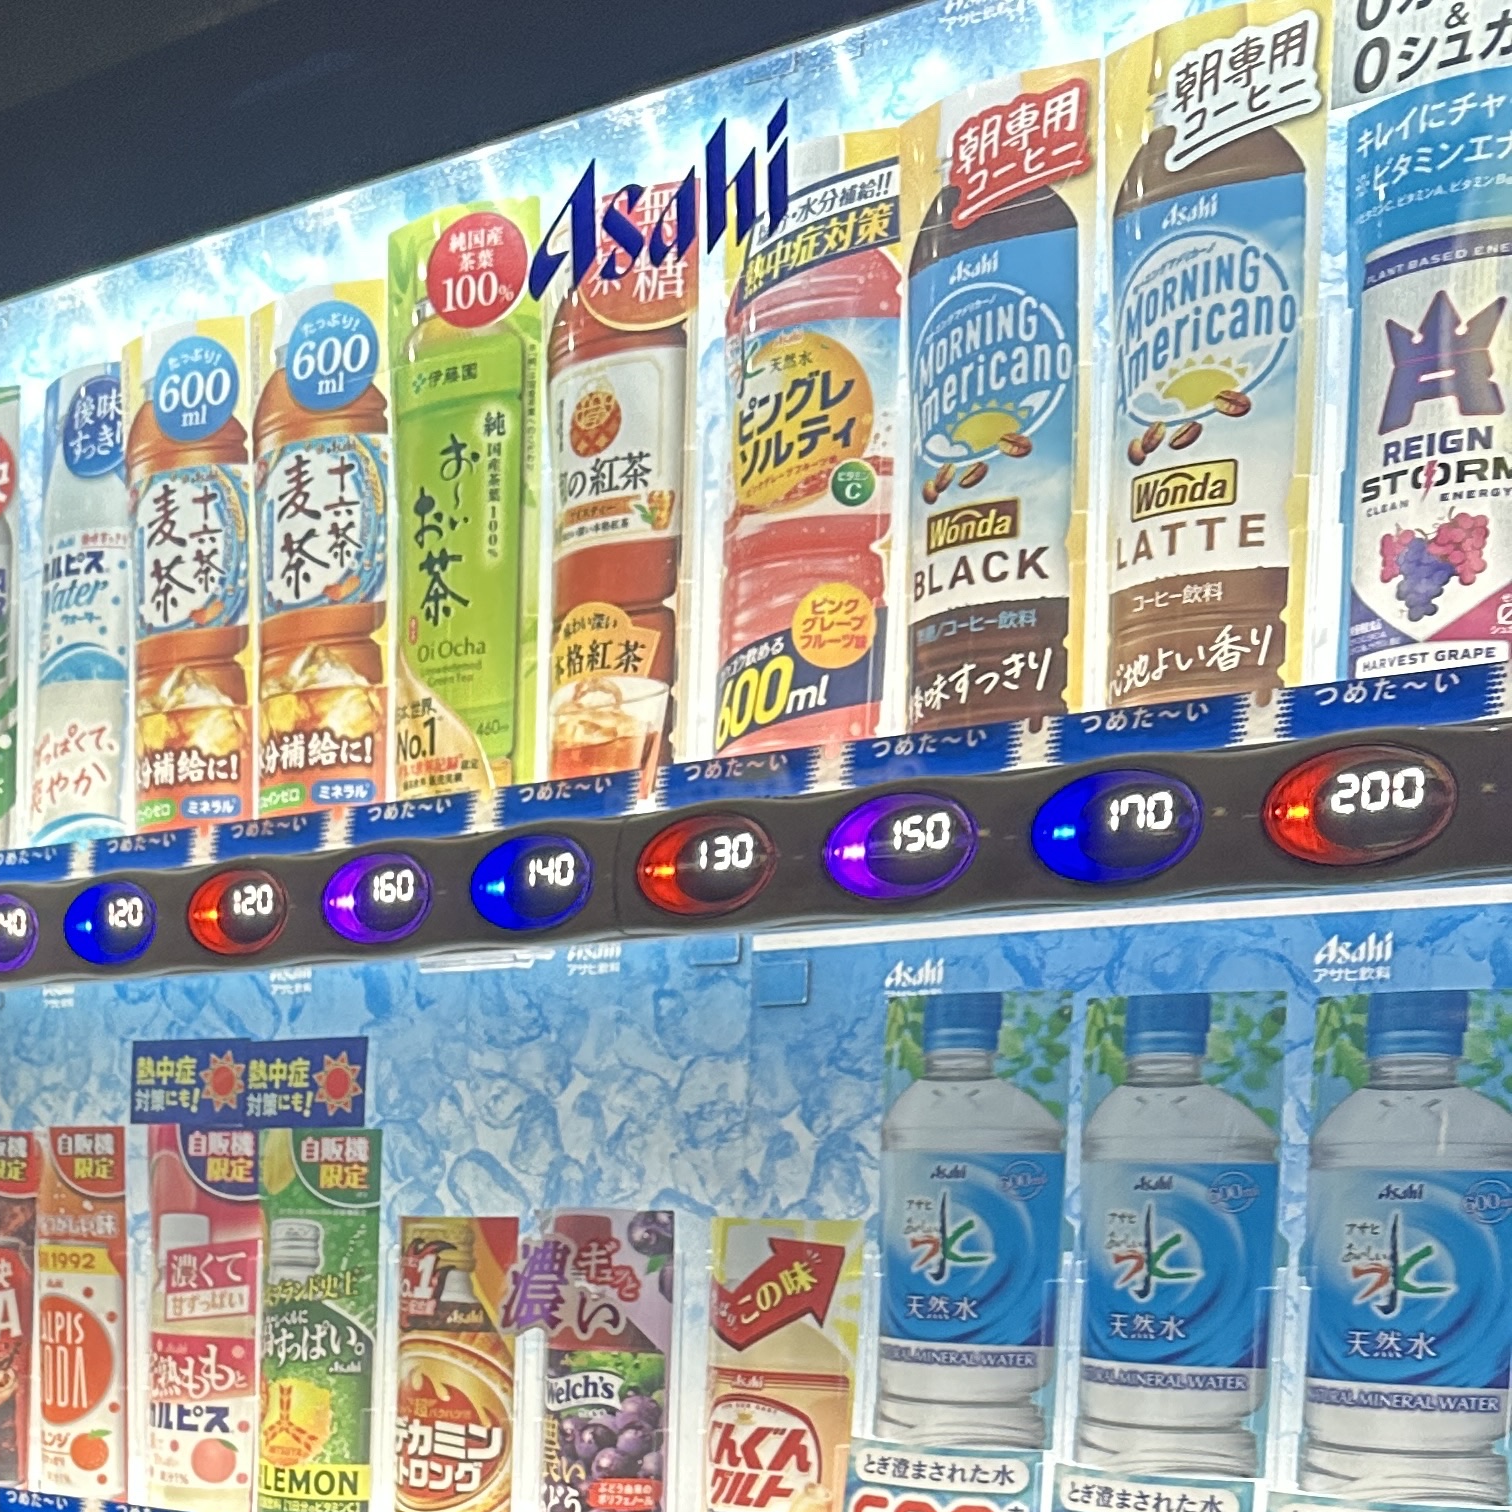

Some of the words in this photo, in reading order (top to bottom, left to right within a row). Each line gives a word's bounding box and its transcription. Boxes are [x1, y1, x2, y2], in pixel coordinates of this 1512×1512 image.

[1175, 20, 1309, 113] 朝専用
[956, 86, 1081, 176] 朝専用
[529, 97, 788, 302] Asahi
[1162, 192, 1218, 230] Asahi
[449, 225, 504, 252] 純国産
[744, 202, 894, 292] 熱中症対策
[458, 249, 494, 273] 茶葉
[949, 251, 999, 286] Asahi
[1408, 246, 1467, 270] BASED
[441, 271, 514, 313] 100%
[1126, 245, 1261, 344] MORNING
[292, 334, 370, 380] 600
[920, 296, 1037, 392] MORNING
[159, 368, 231, 413] 600
[318, 372, 344, 395] ml
[428, 361, 478, 388] 伊藤園
[181, 405, 206, 428] ml
[741, 414, 856, 487] ソルティ
[1383, 426, 1493, 467] REIGN
[844, 481, 861, 500] C
[1135, 472, 1227, 512] Wonda
[278, 454, 330, 600] 麦茶
[324, 459, 361, 569] 十六茶
[930, 510, 1011, 546] Wonda
[189, 487, 226, 588] 十六茶
[1116, 513, 1266, 570] LATTE
[148, 485, 195, 623] 麦茶
[413, 486, 471, 627] お茶
[914, 546, 1050, 601] BLACK
[811, 599, 859, 615] ピンク
[1133, 581, 1223, 613] コーヒー飲料
[801, 613, 868, 633] グレープ
[438, 636, 486, 658] Ocha
[1363, 652, 1429, 672] HARVEST
[1435, 647, 1496, 662] GRAPE
[716, 655, 827, 750] 600ml
[1314, 670, 1462, 707] つめた〜い
[1080, 703, 1210, 735] つめた〜い
[872, 728, 988, 758] つめた〜い
[683, 754, 789, 783] つめた〜い
[518, 776, 613, 802] つめた〜い
[1331, 767, 1426, 814] 200
[367, 797, 452, 822] つめた〜い
[1109, 791, 1174, 831] 170
[892, 812, 952, 853] 150
[698, 833, 755, 870] 130
[371, 869, 415, 903] 160
[528, 852, 575, 888] 140
[108, 897, 144, 928] 120
[233, 884, 274, 916] 120
[1314, 930, 1394, 965] Asahi
[884, 957, 945, 989] Asahi
[1313, 965, 1391, 982] アサヒ飲料
[137, 1056, 197, 1085] 熱中症
[248, 1057, 311, 1089] 熱中症
[135, 1088, 201, 1113] 対策にも!
[246, 1091, 313, 1118] 対策にも!
[189, 1130, 254, 1157] 自販機
[301, 1136, 370, 1163] 自販機
[206, 1157, 254, 1183] 限定
[319, 1163, 369, 1189] 限定
[1134, 1175, 1173, 1191] Asahi
[1378, 1183, 1424, 1200] Asahi
[171, 1252, 247, 1288] 濃くて
[738, 1260, 818, 1324] この味
[906, 1294, 979, 1321] 天然水
[447, 1310, 484, 1324] Asahi
[1109, 1313, 1186, 1341] 天然水
[980, 1352, 1034, 1367] WATER
[1347, 1330, 1437, 1359] 天然水
[547, 1374, 614, 1402] Welch's
[1188, 1374, 1247, 1391] WATER
[1363, 1394, 1435, 1410] MINERAL
[1439, 1395, 1500, 1412] WATER
[262, 1466, 359, 1496] LEMON
[862, 1453, 1016, 1486] とぎ澄まされた水
